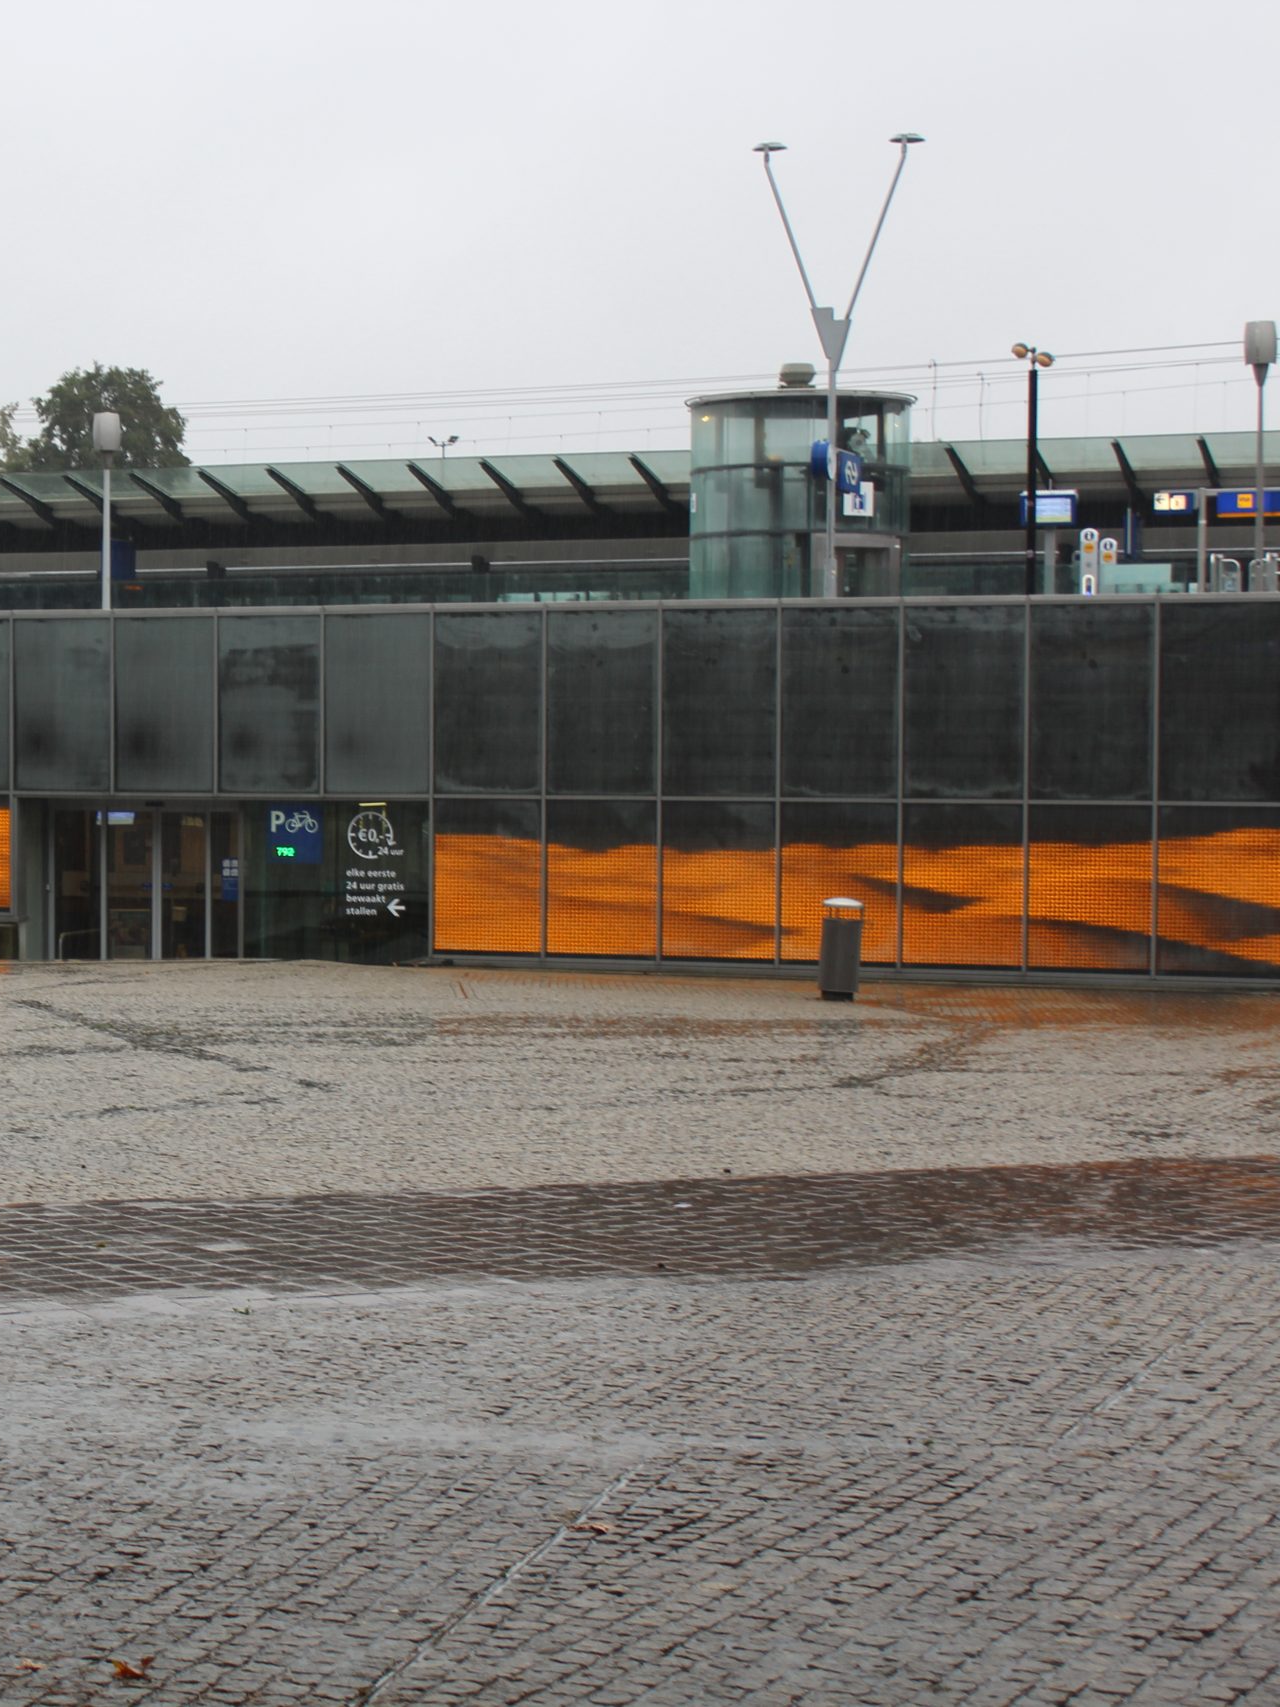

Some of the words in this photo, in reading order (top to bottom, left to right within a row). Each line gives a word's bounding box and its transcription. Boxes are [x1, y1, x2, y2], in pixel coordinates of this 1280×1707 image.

[270, 810, 286, 833] P
[276, 846, 296, 857] 792
[377, 846, 389, 856] 24
[346, 868, 366, 878] elke
[367, 869, 396, 878] eerste
[346, 881, 358, 890] 24
[359, 882, 375, 891] uur
[377, 881, 405, 893] gratis
[346, 893, 386, 903] bewaakt
[345, 907, 378, 916] stallen
